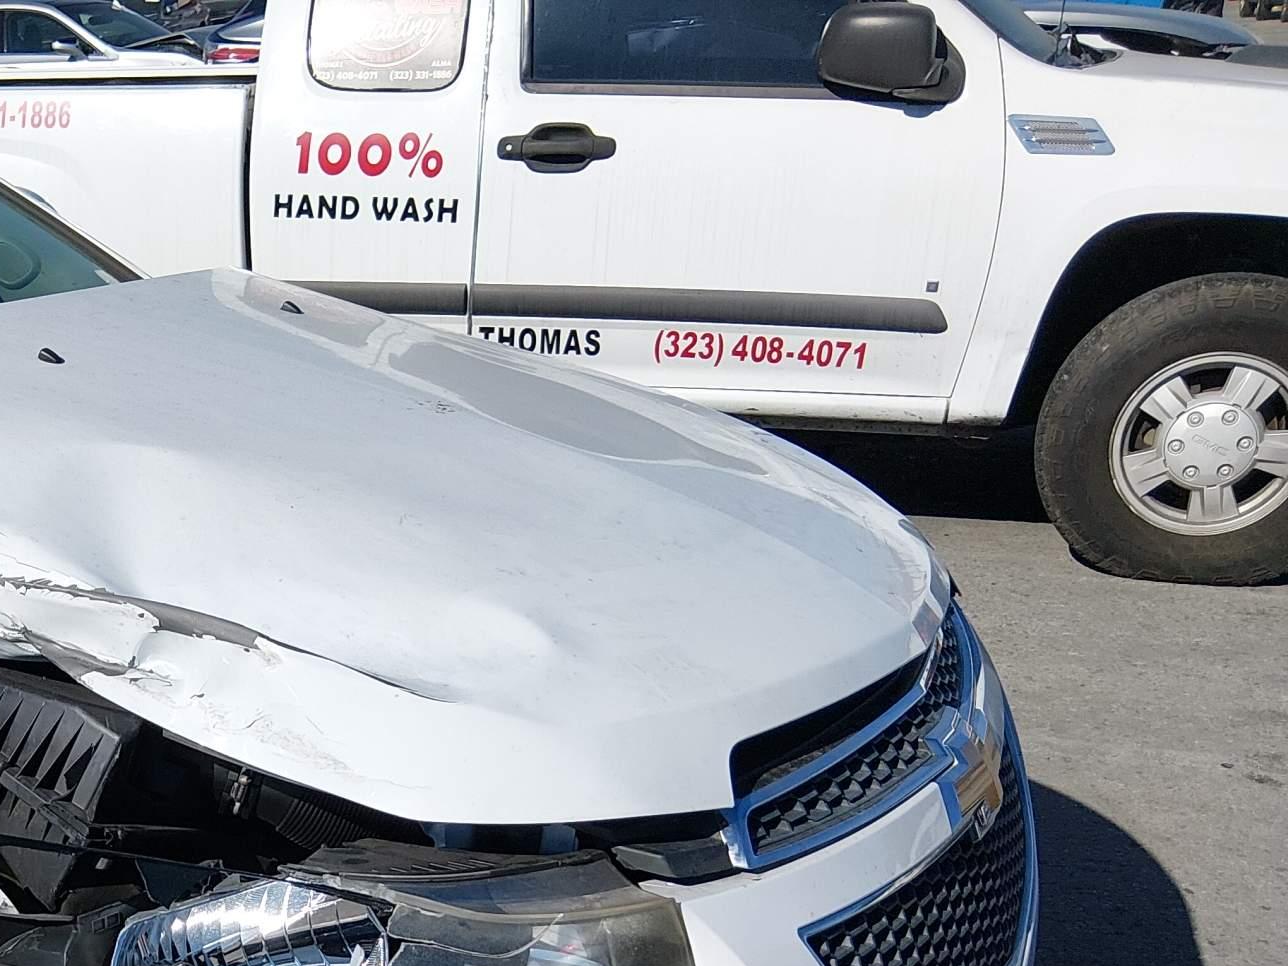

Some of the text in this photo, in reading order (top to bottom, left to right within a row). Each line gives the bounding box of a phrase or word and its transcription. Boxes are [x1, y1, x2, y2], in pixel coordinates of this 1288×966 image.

[296, 131, 444, 178] 100%
[273, 194, 459, 223] HAND WASH
[478, 326, 867, 370] THOMAS (323) 408-4071
